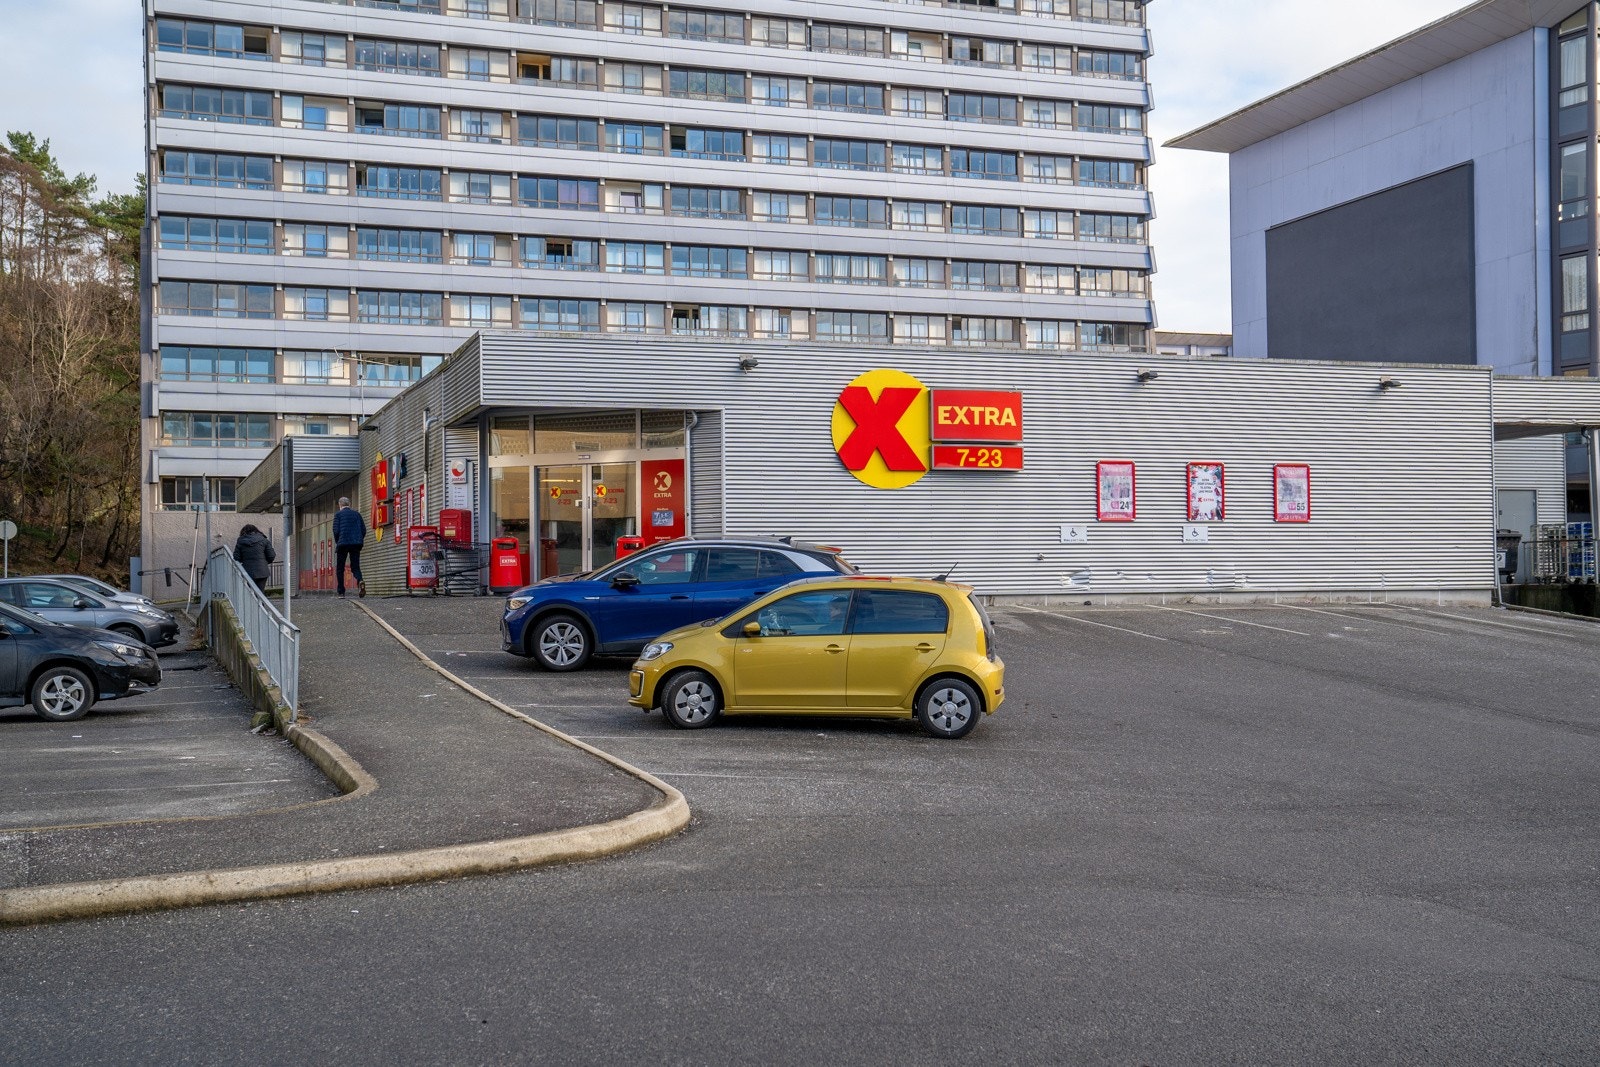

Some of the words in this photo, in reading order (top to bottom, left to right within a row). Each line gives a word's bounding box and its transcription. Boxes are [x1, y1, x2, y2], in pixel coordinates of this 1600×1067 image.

[838, 386, 927, 471] X
[938, 405, 1017, 427] EXTRA
[957, 448, 1003, 468] 7-23
[1120, 500, 1130, 510] 24
[1296, 502, 1306, 511] 55
[418, 565, 434, 574] -30%
